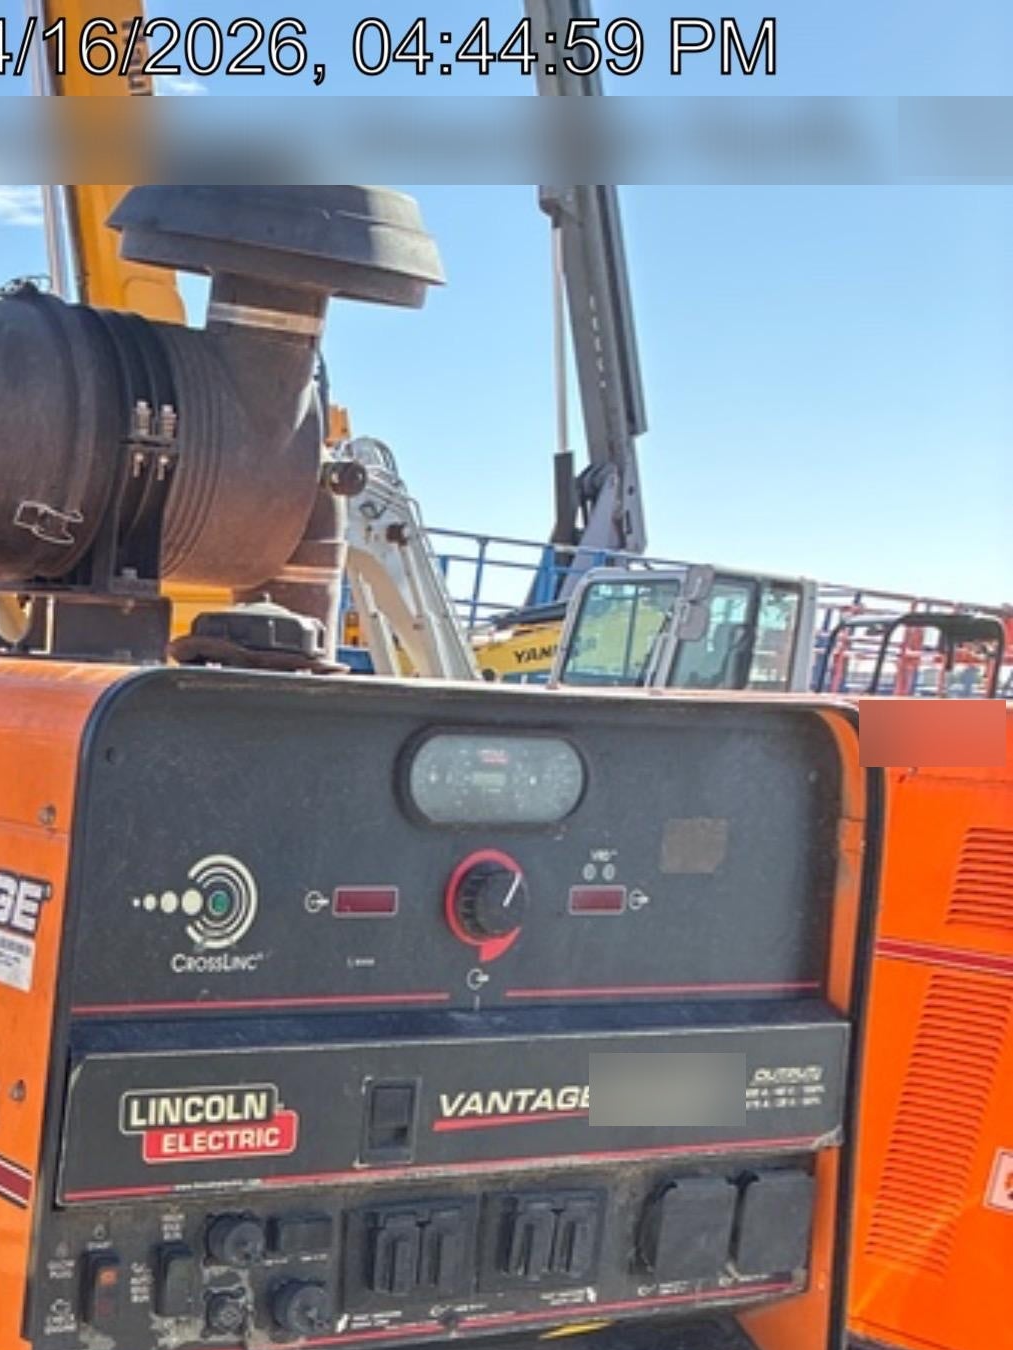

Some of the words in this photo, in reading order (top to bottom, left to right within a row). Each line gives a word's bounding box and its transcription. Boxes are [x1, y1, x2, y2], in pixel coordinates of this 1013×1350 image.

[513, 644, 558, 664] YAN
[130, 1092, 268, 1127] LINCOLN
[161, 1127, 281, 1154] ELECTRIC
